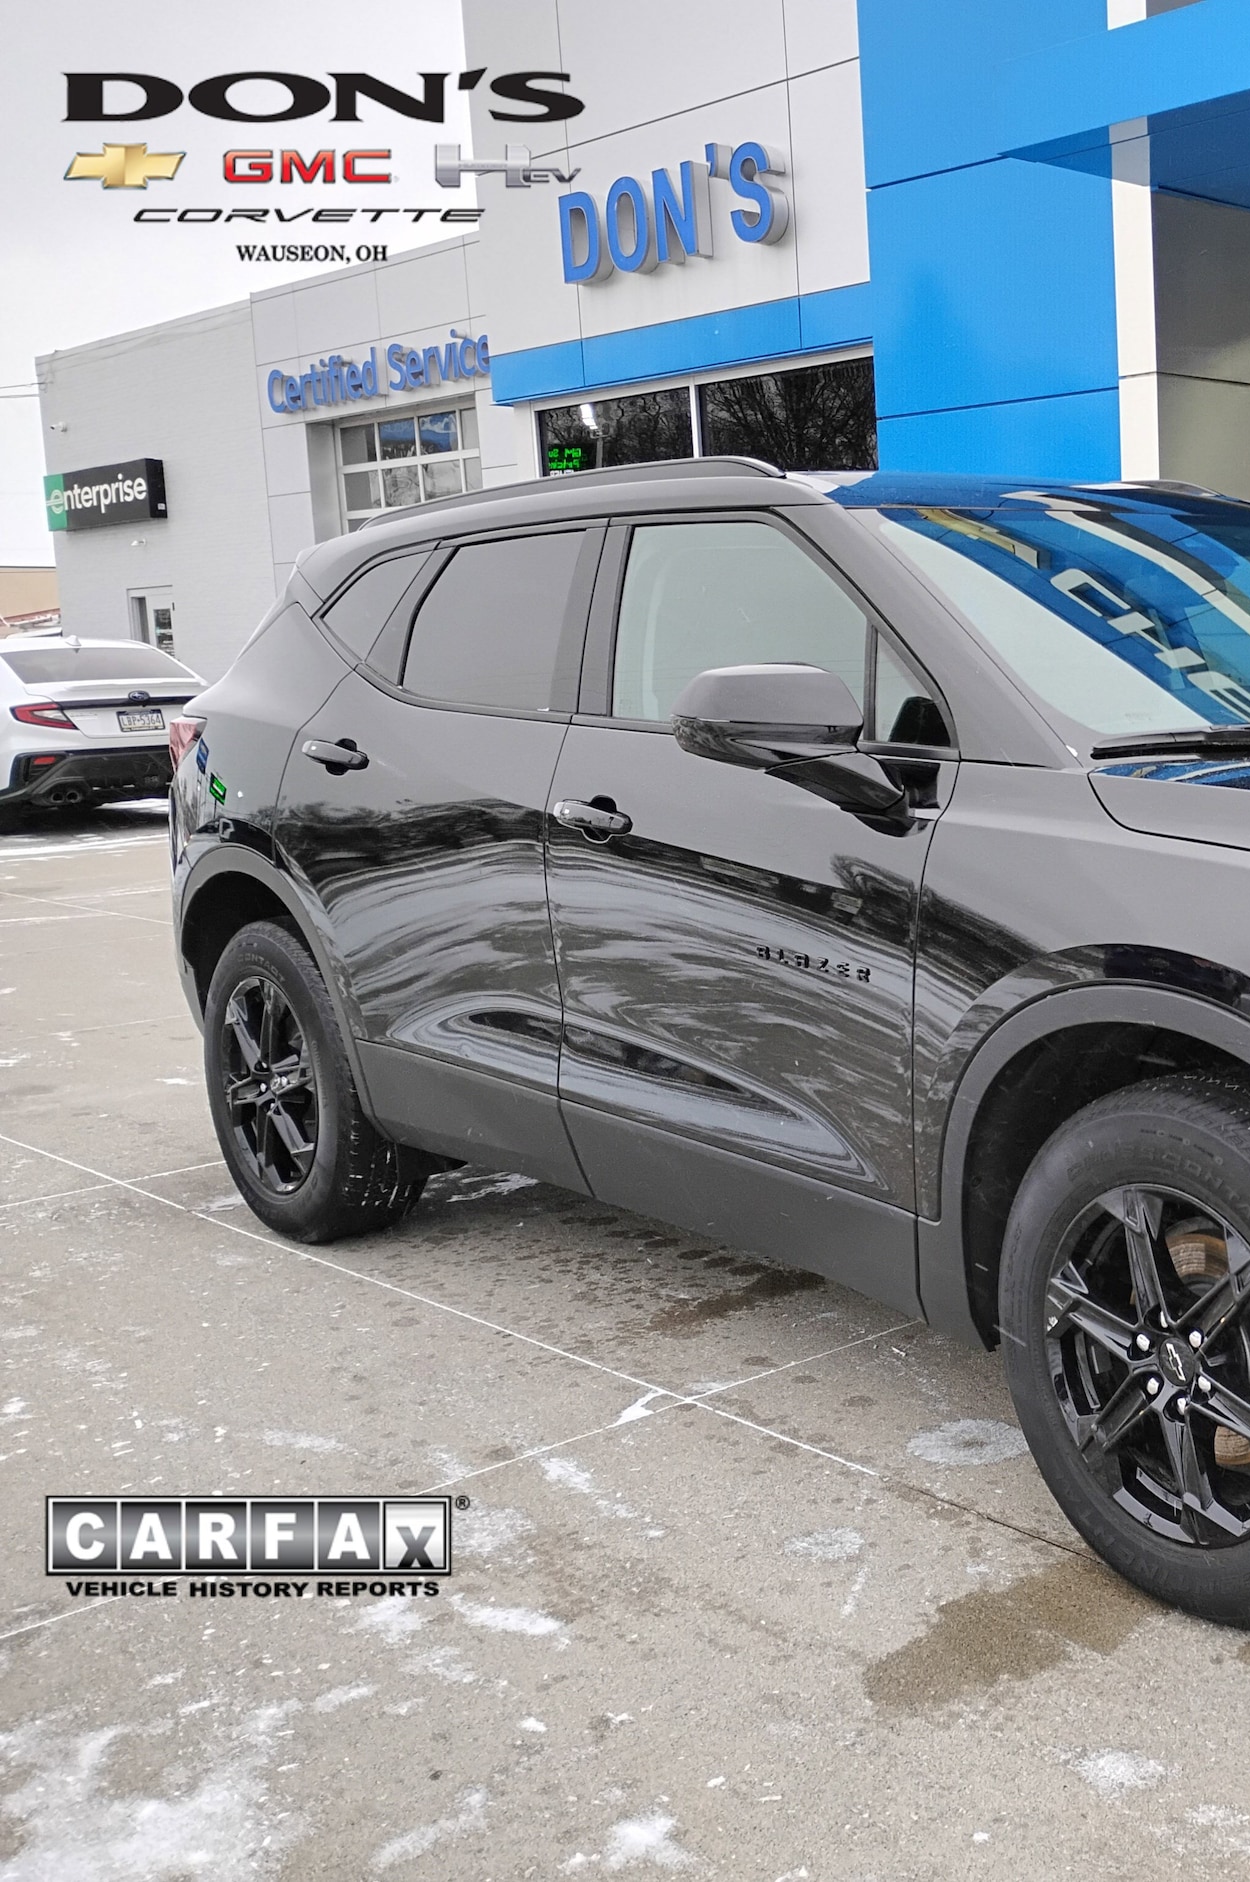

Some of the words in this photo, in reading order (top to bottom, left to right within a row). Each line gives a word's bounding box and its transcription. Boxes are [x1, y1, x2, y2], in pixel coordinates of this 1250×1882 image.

[558, 141, 778, 284] DON'S
[268, 347, 379, 413] Certified
[387, 329, 491, 391] Service
[47, 473, 147, 514] enterprise
[756, 945, 872, 983] BLAZER
